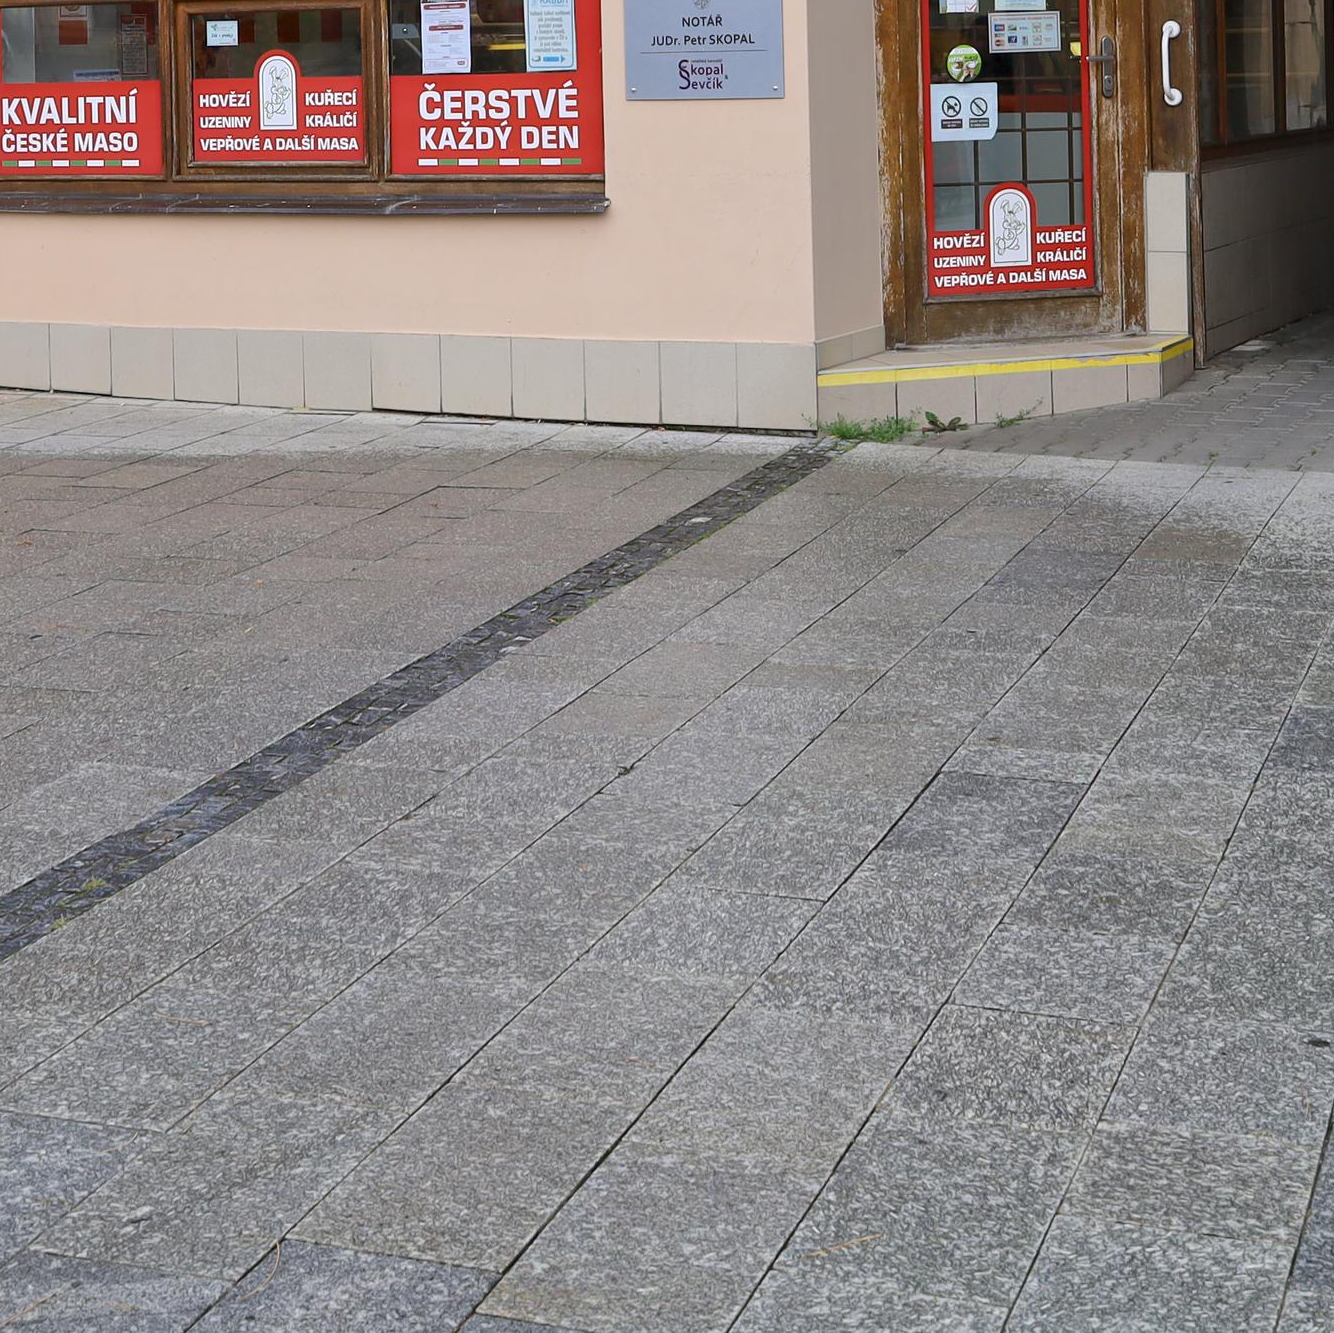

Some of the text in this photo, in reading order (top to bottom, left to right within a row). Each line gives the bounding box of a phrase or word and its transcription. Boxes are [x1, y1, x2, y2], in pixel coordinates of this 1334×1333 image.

[682, 14, 723, 27] NOTÁŘ
[651, 33, 756, 47] JUDr. Petr SKOPAL
[199, 91, 251, 108] HOVĚZÍ
[305, 89, 357, 106] KUŘECÍ
[419, 80, 579, 120] ČERSTVÉ
[1, 88, 138, 125] KVALITNÍ
[200, 116, 251, 128] UZENINY
[305, 111, 357, 128] KRÁLIČÍ
[1, 128, 138, 153] ČESKÉ MASO
[200, 135, 358, 151] VEPŘOVÉ A DALŠÍ MASA
[420, 120, 579, 150] KAŽDÝ DEN
[933, 232, 985, 249] HOVĚZÍ
[1036, 227, 1086, 244] KUŘECÍ
[934, 255, 986, 268] UZENINY
[1037, 246, 1086, 263] KRÁLIČÍ
[935, 268, 1087, 288] VEPŘOVÉ A DALŠÍ MASA
